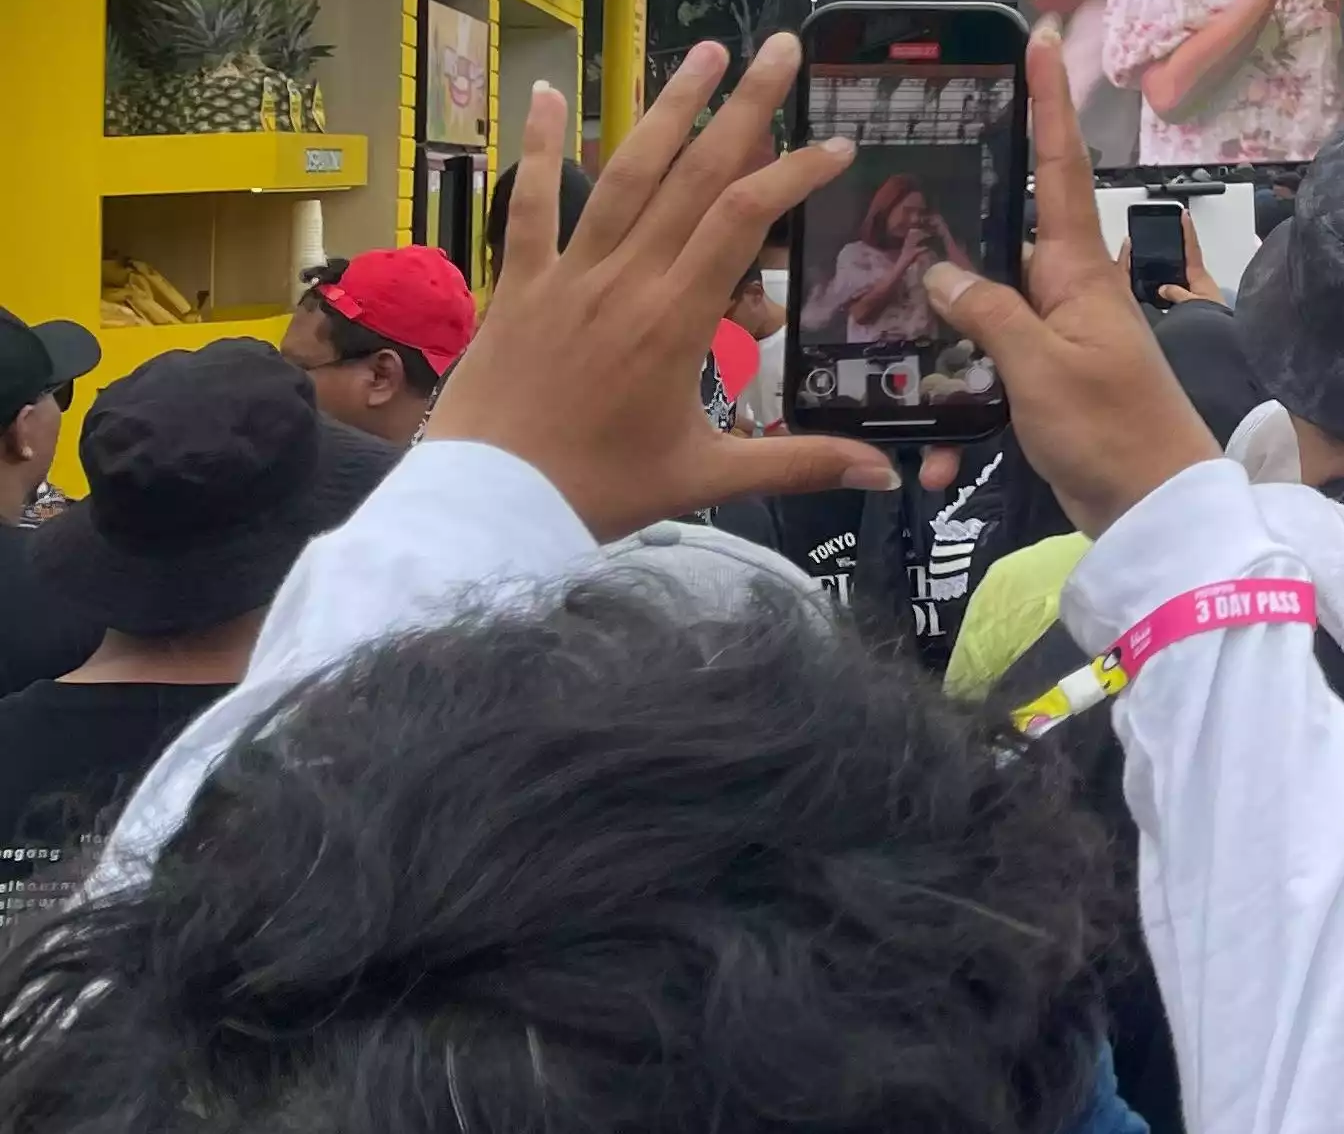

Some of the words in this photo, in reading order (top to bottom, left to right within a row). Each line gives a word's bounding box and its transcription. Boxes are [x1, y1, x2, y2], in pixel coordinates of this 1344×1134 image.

[807, 531, 857, 564] TOKYO
[1195, 599, 1211, 624] 3
[1215, 592, 1252, 620] DAY
[1256, 590, 1301, 615] PASS
